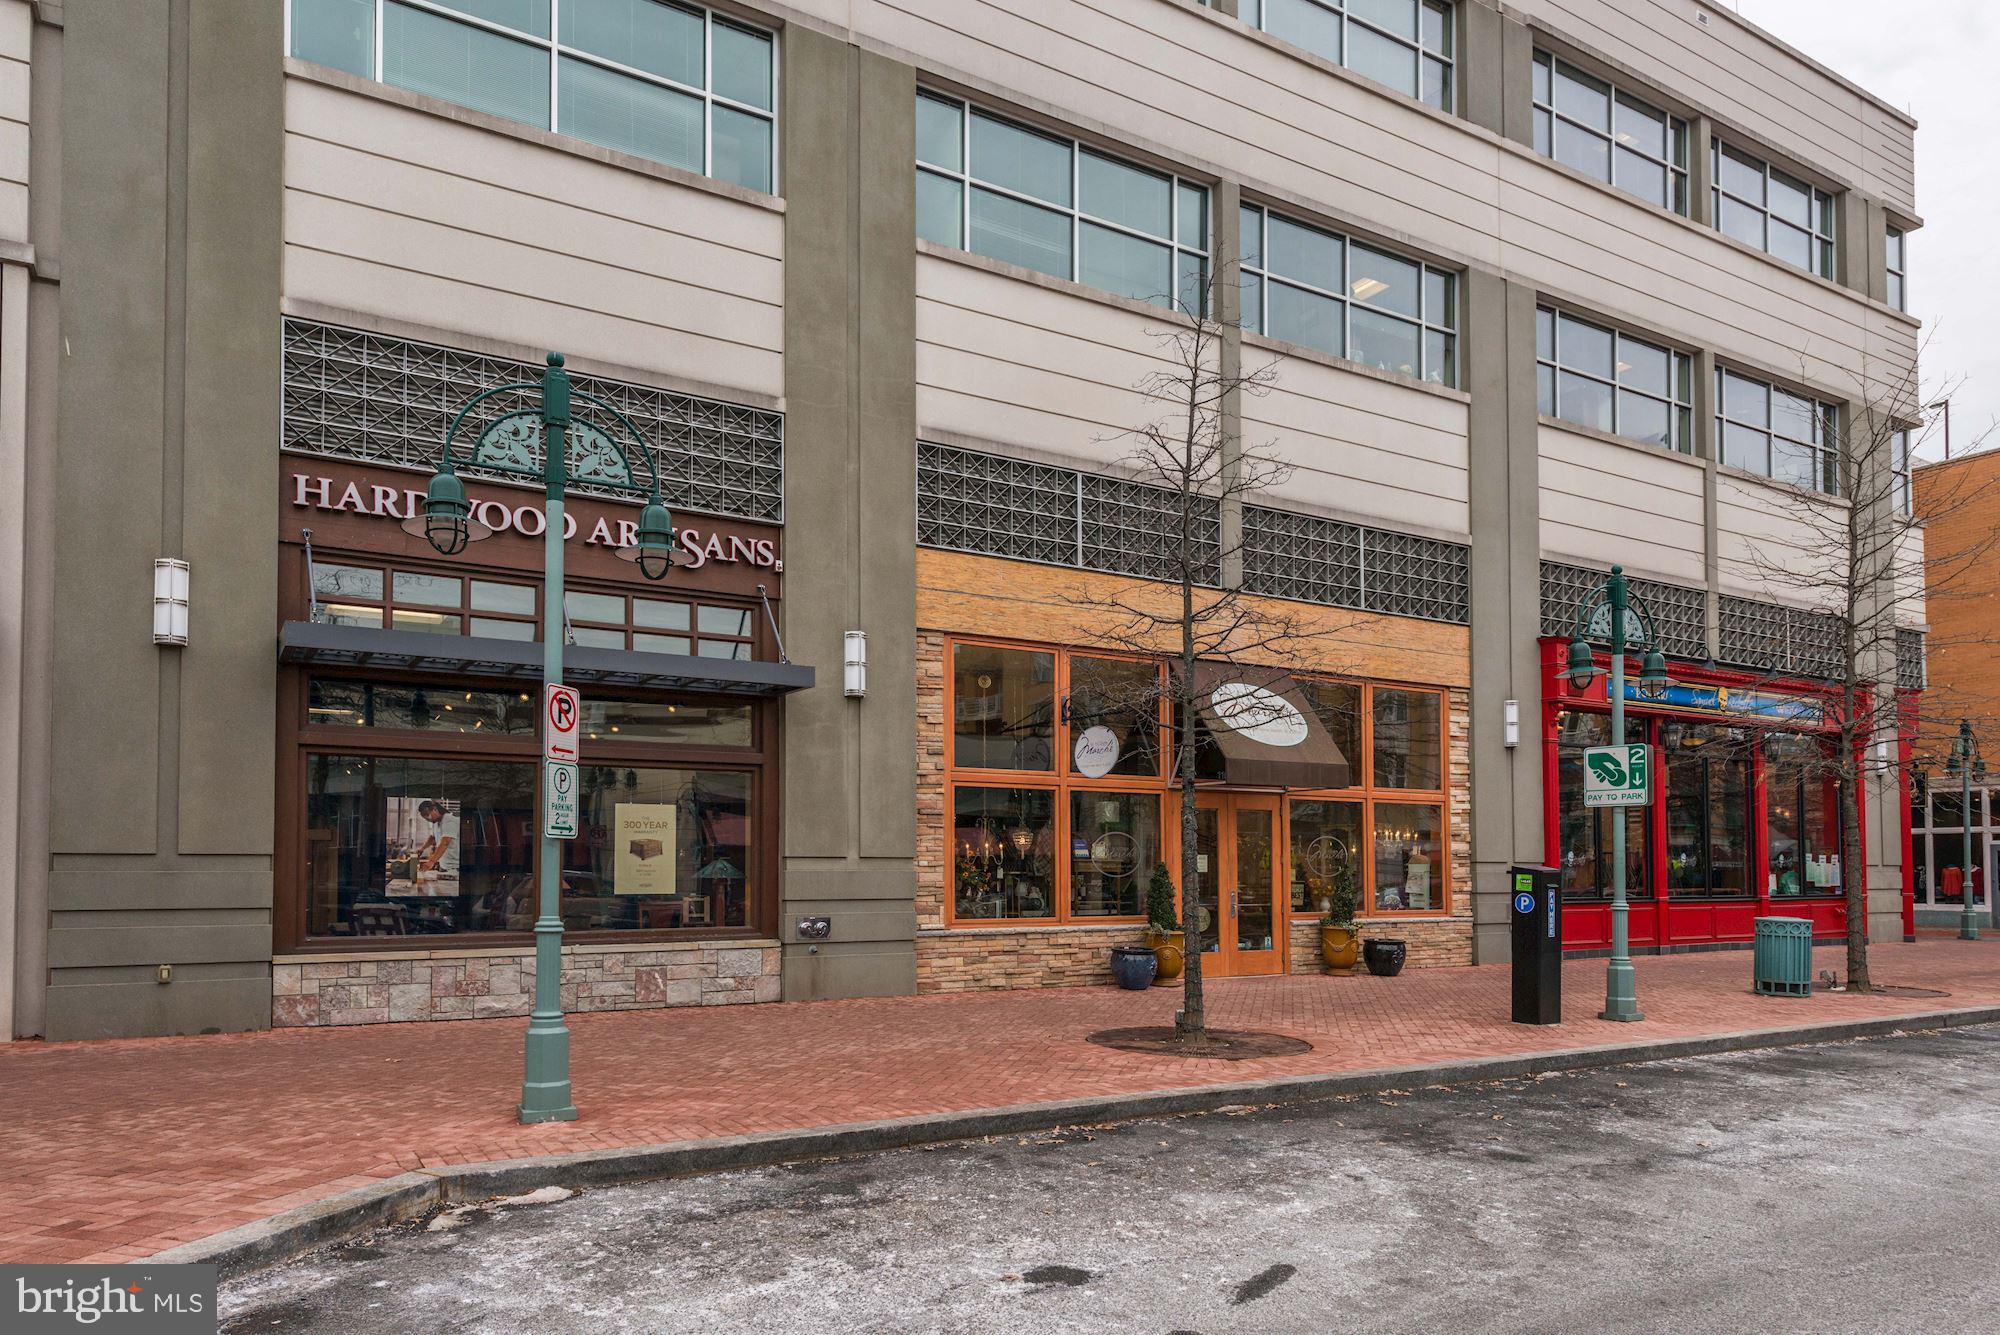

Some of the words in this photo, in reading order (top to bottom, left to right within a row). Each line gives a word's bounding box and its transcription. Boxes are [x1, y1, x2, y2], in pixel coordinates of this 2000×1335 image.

[292, 473, 577, 540] HARDOO
[585, 516, 775, 569] ARSANS
[1630, 748, 1645, 764] 2
[557, 794, 568, 803] PAY
[1607, 793, 1618, 801] TO
[1621, 792, 1643, 800] PARK
[551, 802, 573, 812] PARKING
[555, 812, 561, 825] 2
[623, 820, 642, 829] 300
[643, 821, 669, 830] YEAR
[1520, 896, 1530, 910] P
